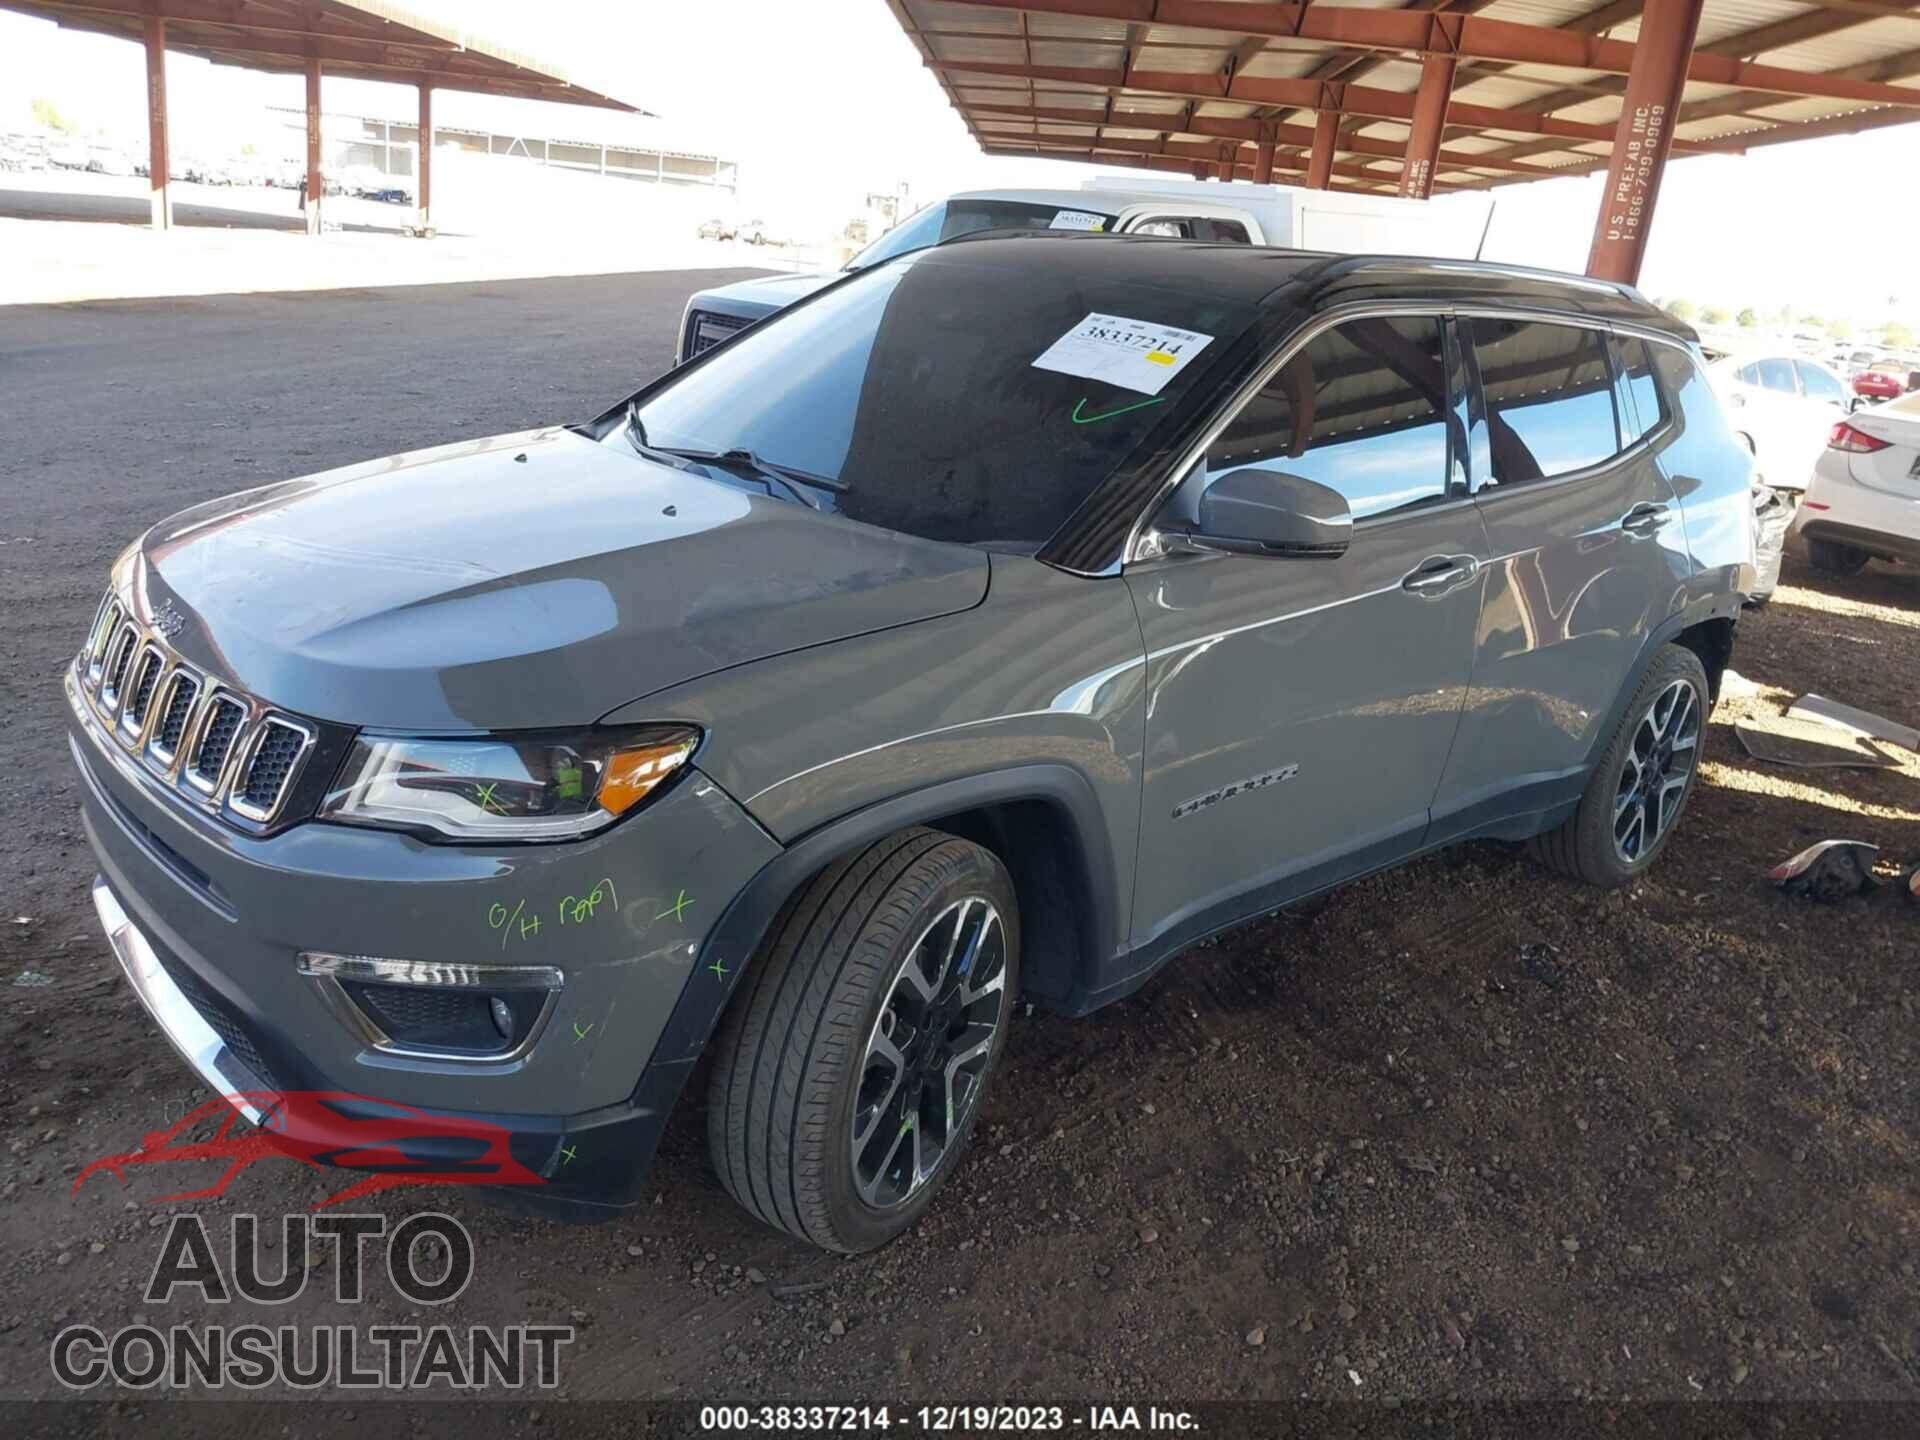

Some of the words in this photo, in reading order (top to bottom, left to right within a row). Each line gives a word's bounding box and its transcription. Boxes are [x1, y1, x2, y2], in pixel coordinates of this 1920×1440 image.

[1616, 141, 1641, 202] PREFAB
[1622, 105, 1665, 240] 1-866-799-0969
[1079, 325, 1184, 355] 38337214
